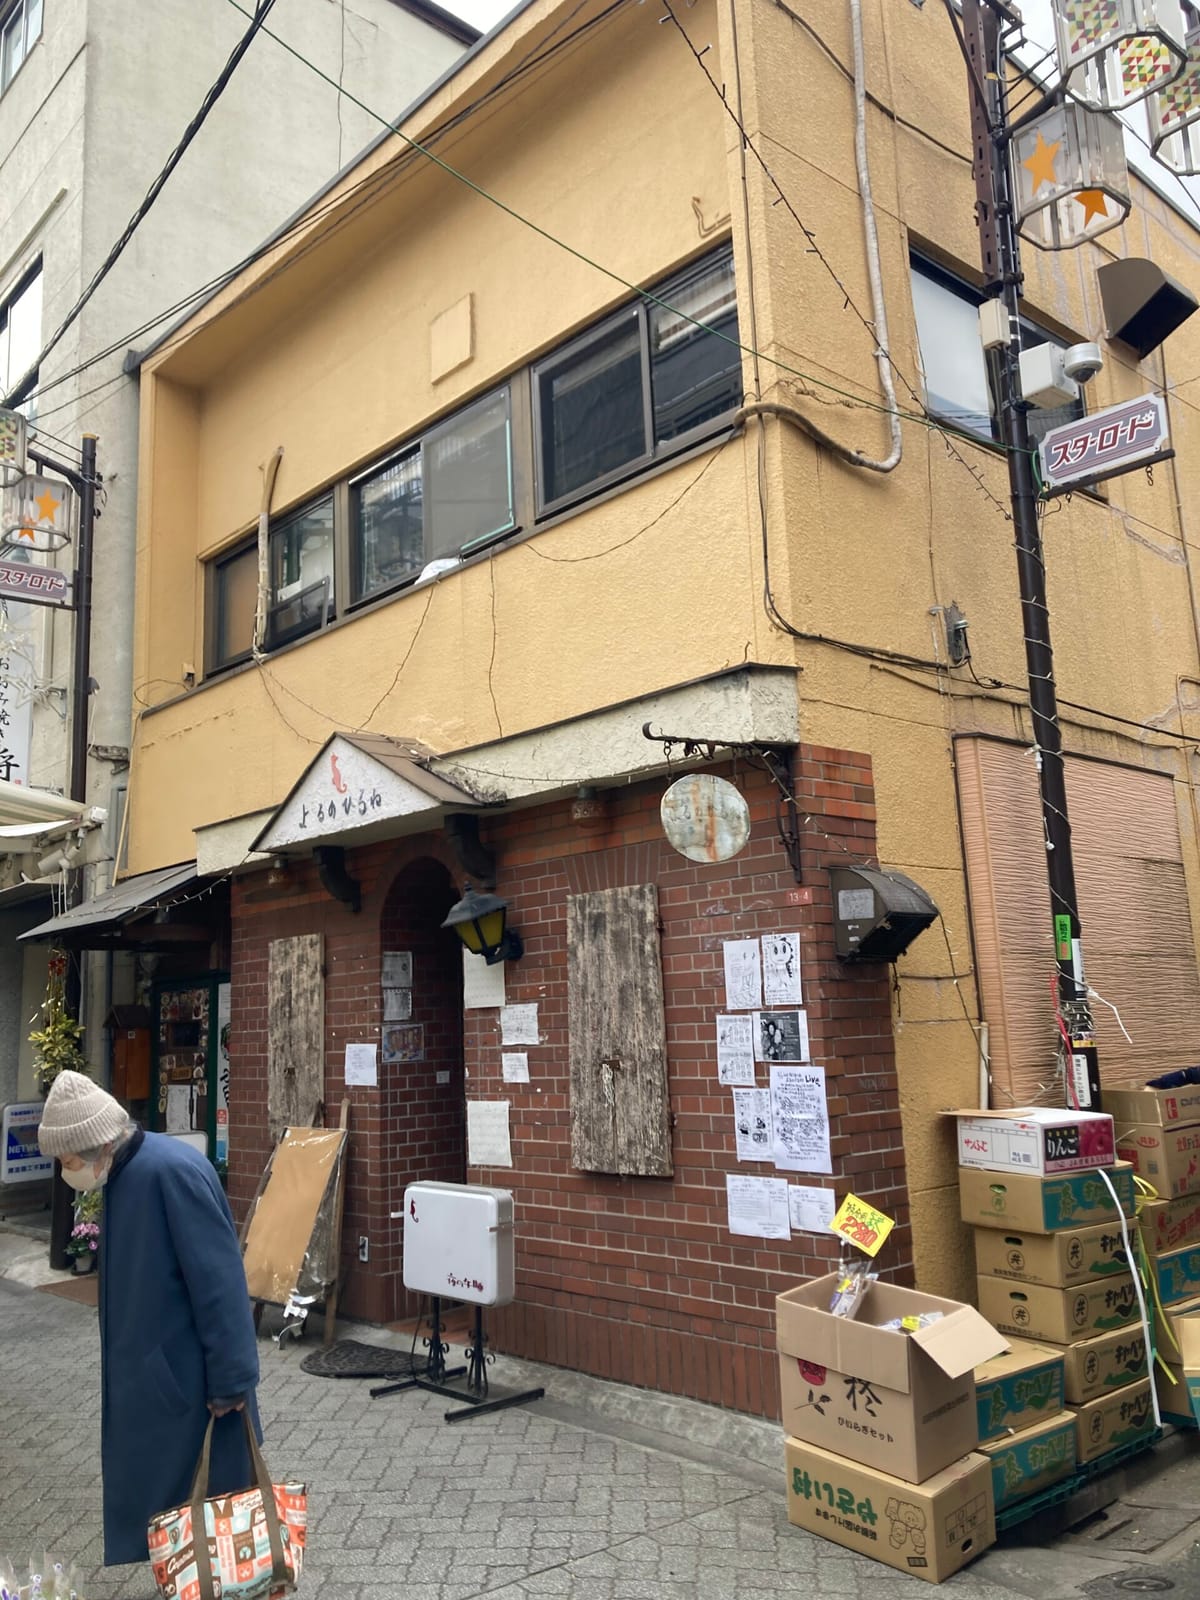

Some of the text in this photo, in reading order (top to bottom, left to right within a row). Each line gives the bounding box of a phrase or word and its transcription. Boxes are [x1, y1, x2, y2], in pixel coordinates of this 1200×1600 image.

[1049, 409, 1155, 471] スターロード
[299, 788, 382, 828] よるのひるね
[789, 891, 809, 903] 13-4
[1048, 1137, 1078, 1159] りんご
[840, 1215, 878, 1248] 280
[837, 1416, 894, 1444] ひいらぎセット
[792, 1467, 878, 1526] やさい村
